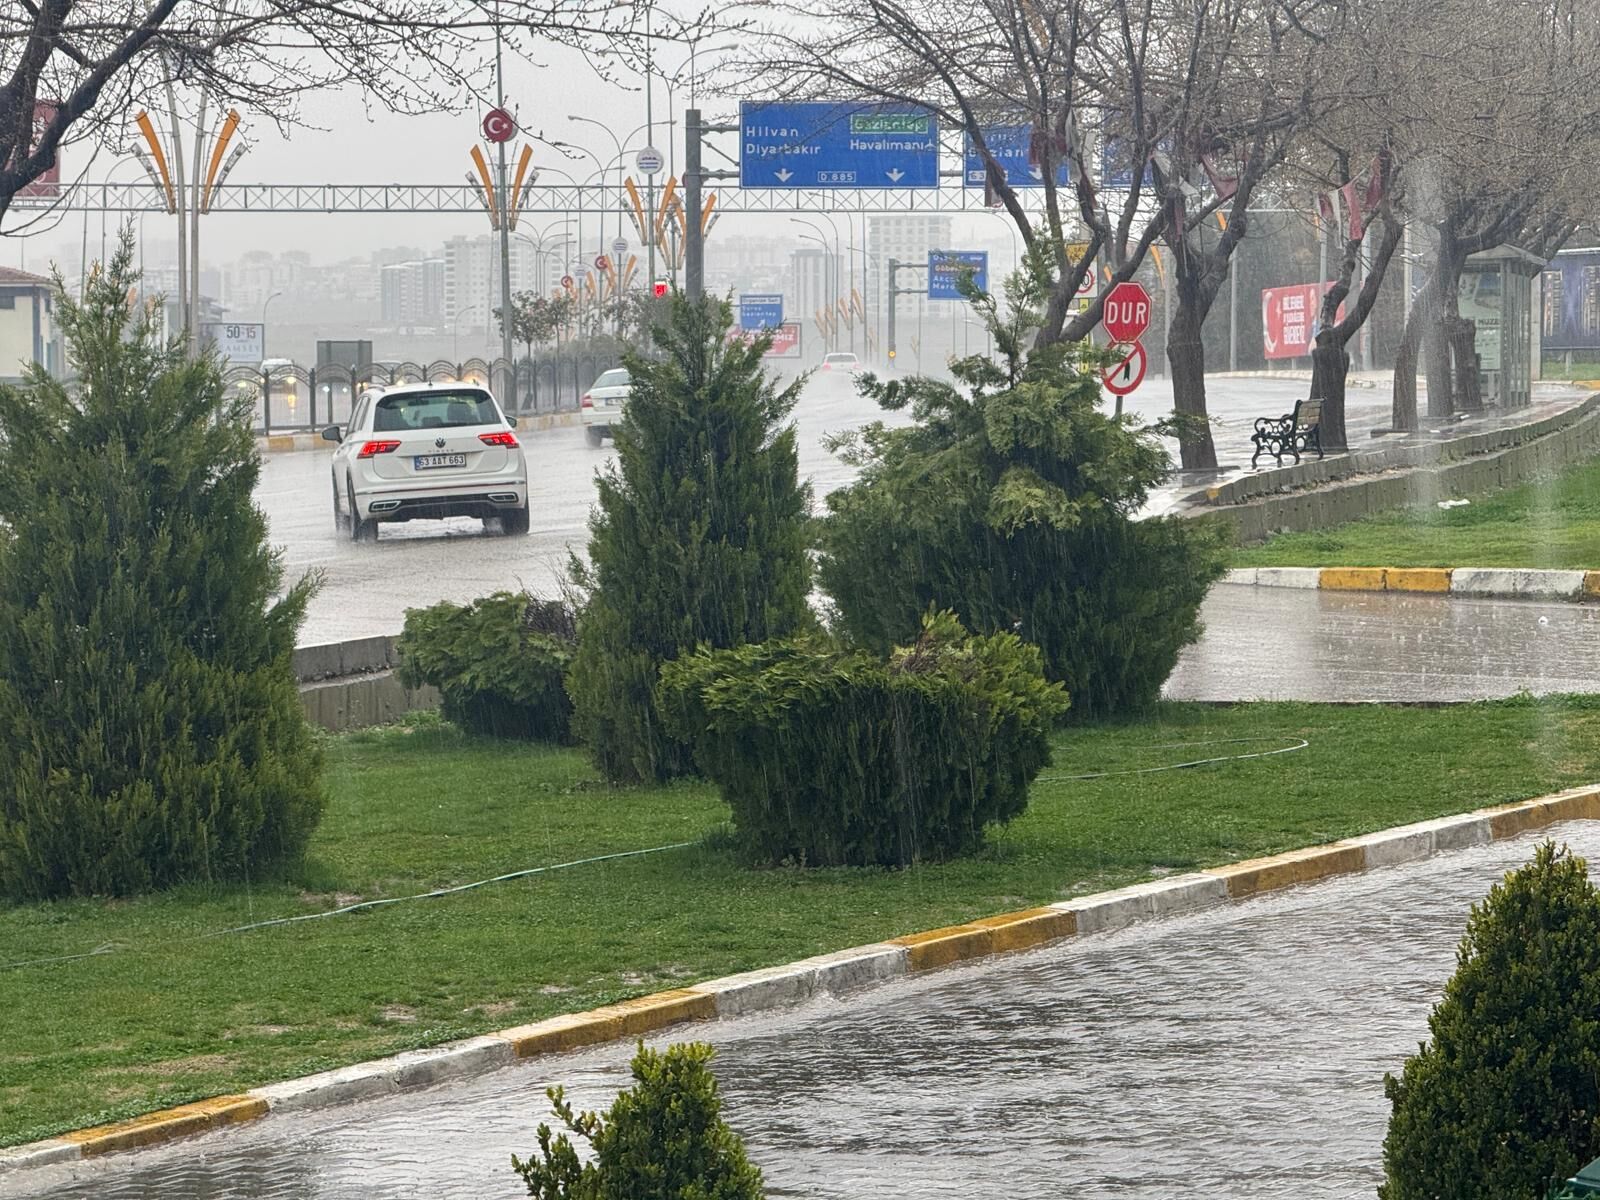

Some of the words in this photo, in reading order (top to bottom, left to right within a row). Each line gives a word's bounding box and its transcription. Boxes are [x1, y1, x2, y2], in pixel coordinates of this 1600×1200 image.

[746, 126, 799, 137] Hilvan
[854, 119, 923, 132] Gaziantep
[746, 143, 821, 157] Diyarbakır
[1107, 302, 1147, 325] DUR
[448, 455, 464, 464] 663
